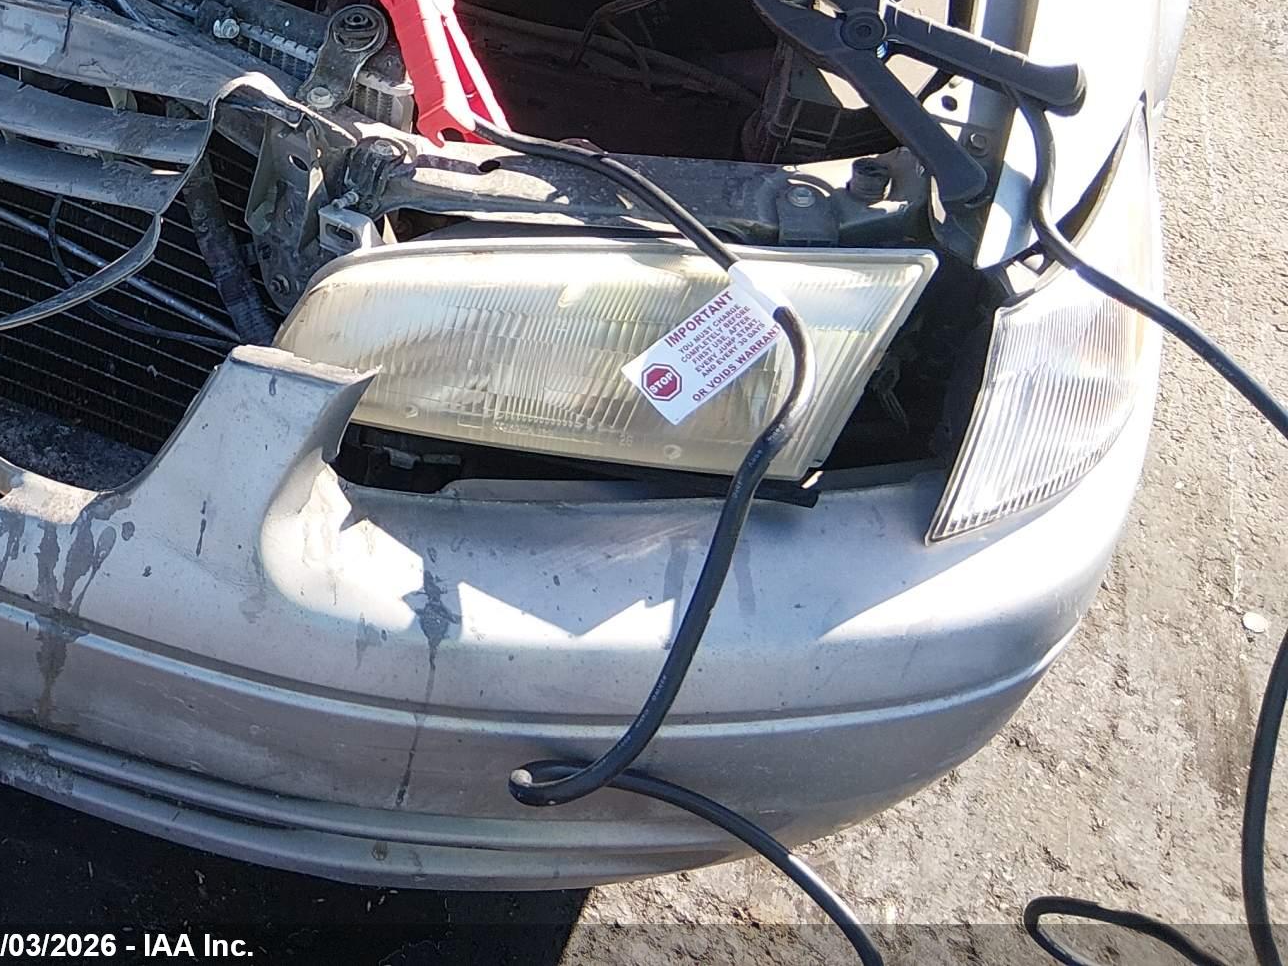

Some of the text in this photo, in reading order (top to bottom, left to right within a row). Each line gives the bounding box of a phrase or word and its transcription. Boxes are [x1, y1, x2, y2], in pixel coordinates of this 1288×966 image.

[664, 290, 734, 347] IMPORTANT
[678, 303, 741, 355] YOU MUST CHARGE
[680, 305, 750, 363] COMPLETELY BEFORE
[691, 315, 750, 364] FIRST USE, AFTER
[691, 323, 780, 402] OR VOIDS WARRANT
[695, 352, 718, 373] EVERY
[717, 337, 737, 354] JUMP
[701, 322, 765, 377] AND EVERY 30 DAYS
[648, 371, 675, 394] STOP
